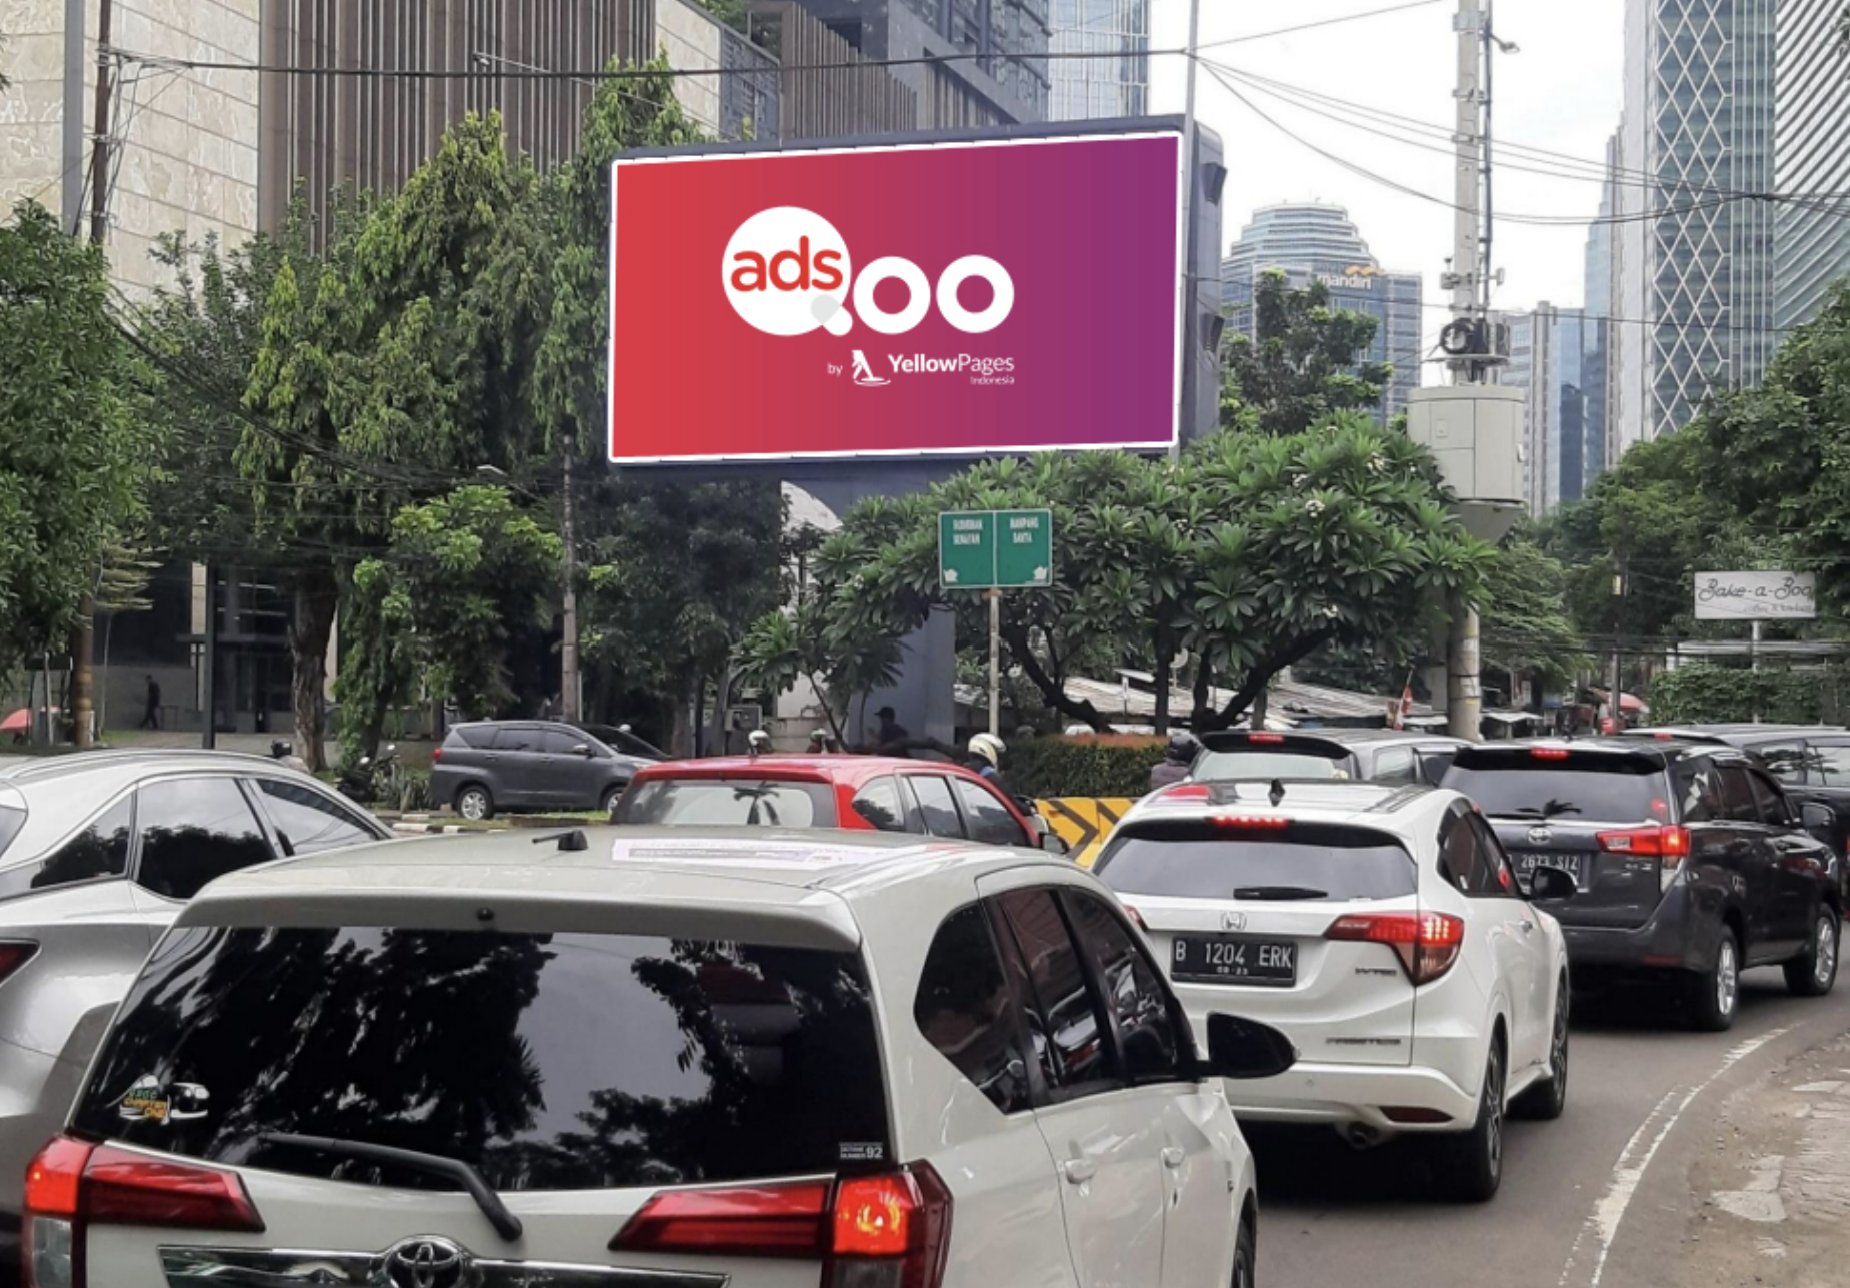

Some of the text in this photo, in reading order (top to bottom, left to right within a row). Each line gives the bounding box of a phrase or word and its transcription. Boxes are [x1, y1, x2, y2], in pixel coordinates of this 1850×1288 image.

[827, 353, 1015, 376] by YellowPages
[970, 375, 1015, 385] Indonesia
[1175, 941, 1292, 968] B 1204 ERK
[866, 1146, 883, 1159] 92
